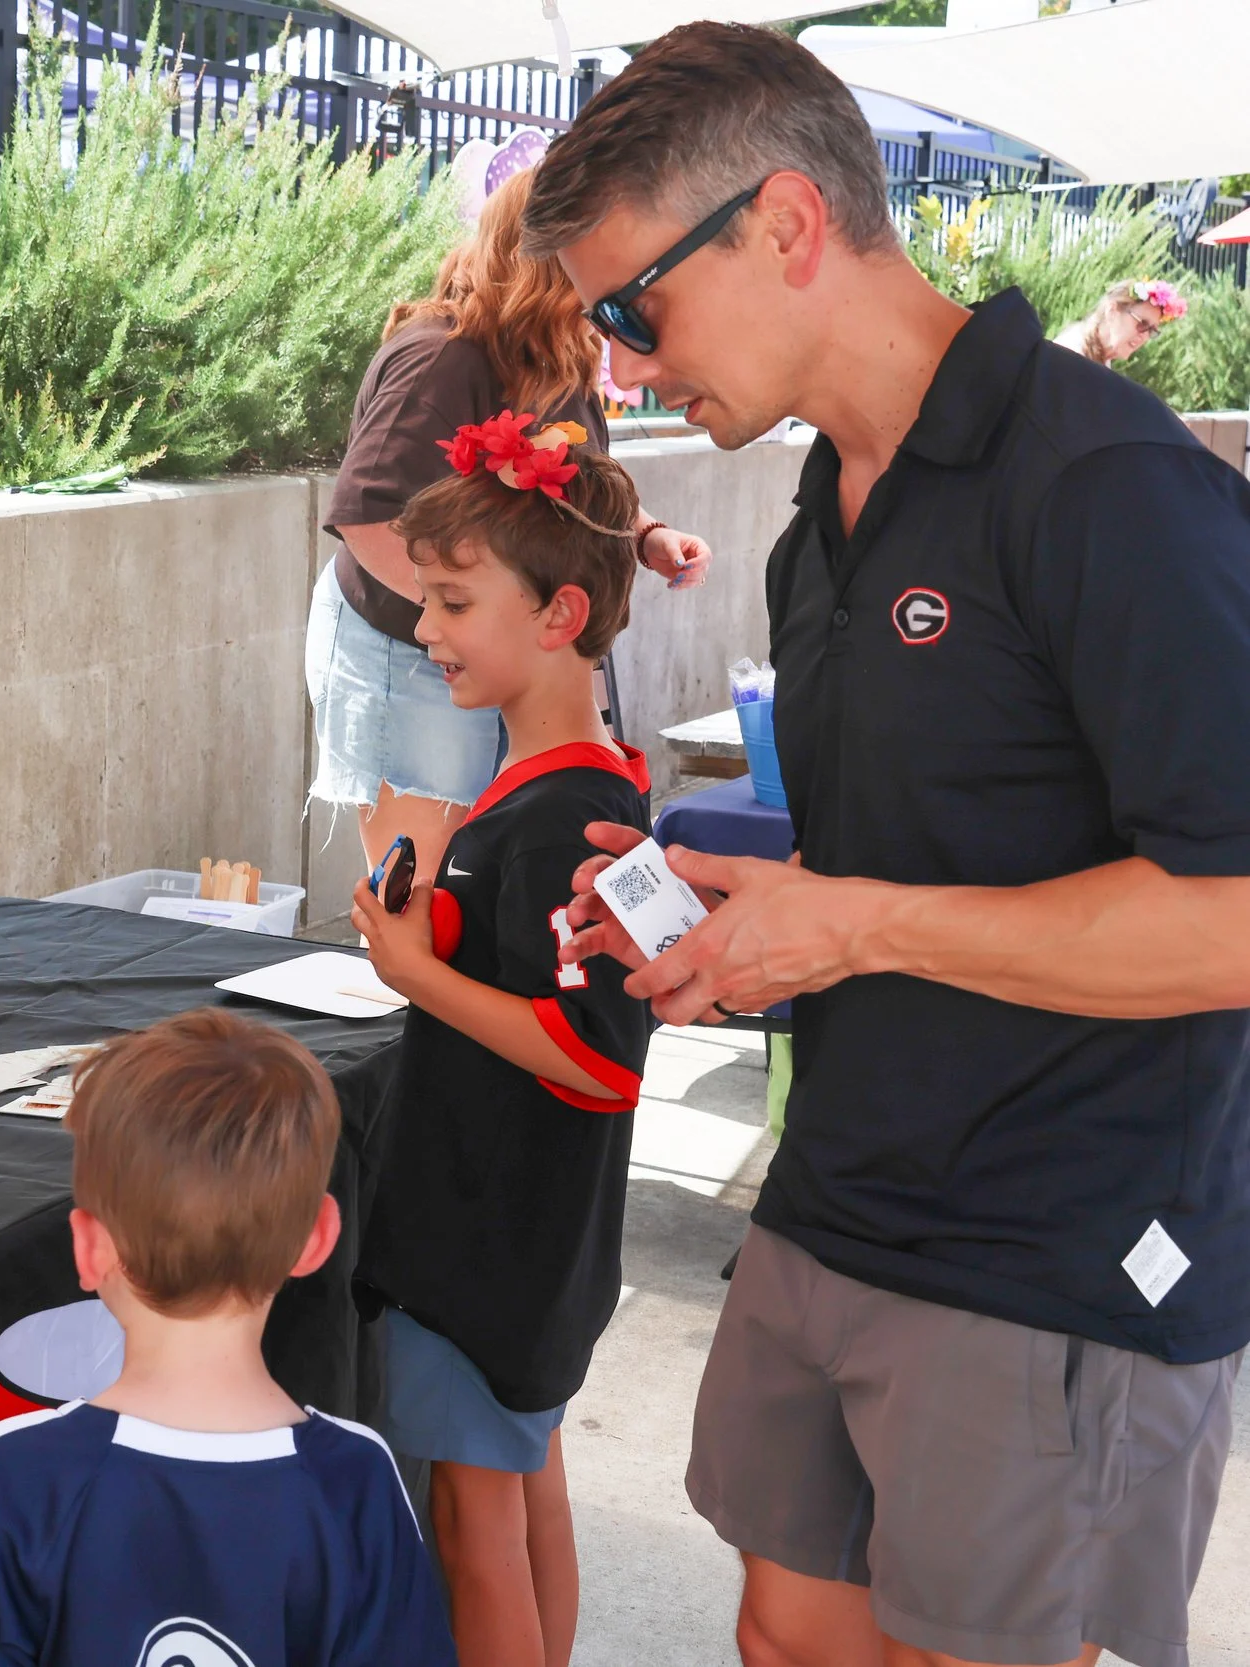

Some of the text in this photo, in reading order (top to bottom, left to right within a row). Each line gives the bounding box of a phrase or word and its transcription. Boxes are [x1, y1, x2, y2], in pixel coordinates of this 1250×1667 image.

[639, 267, 657, 286] goodr
[892, 586, 950, 645] G
[548, 905, 589, 991] 1
